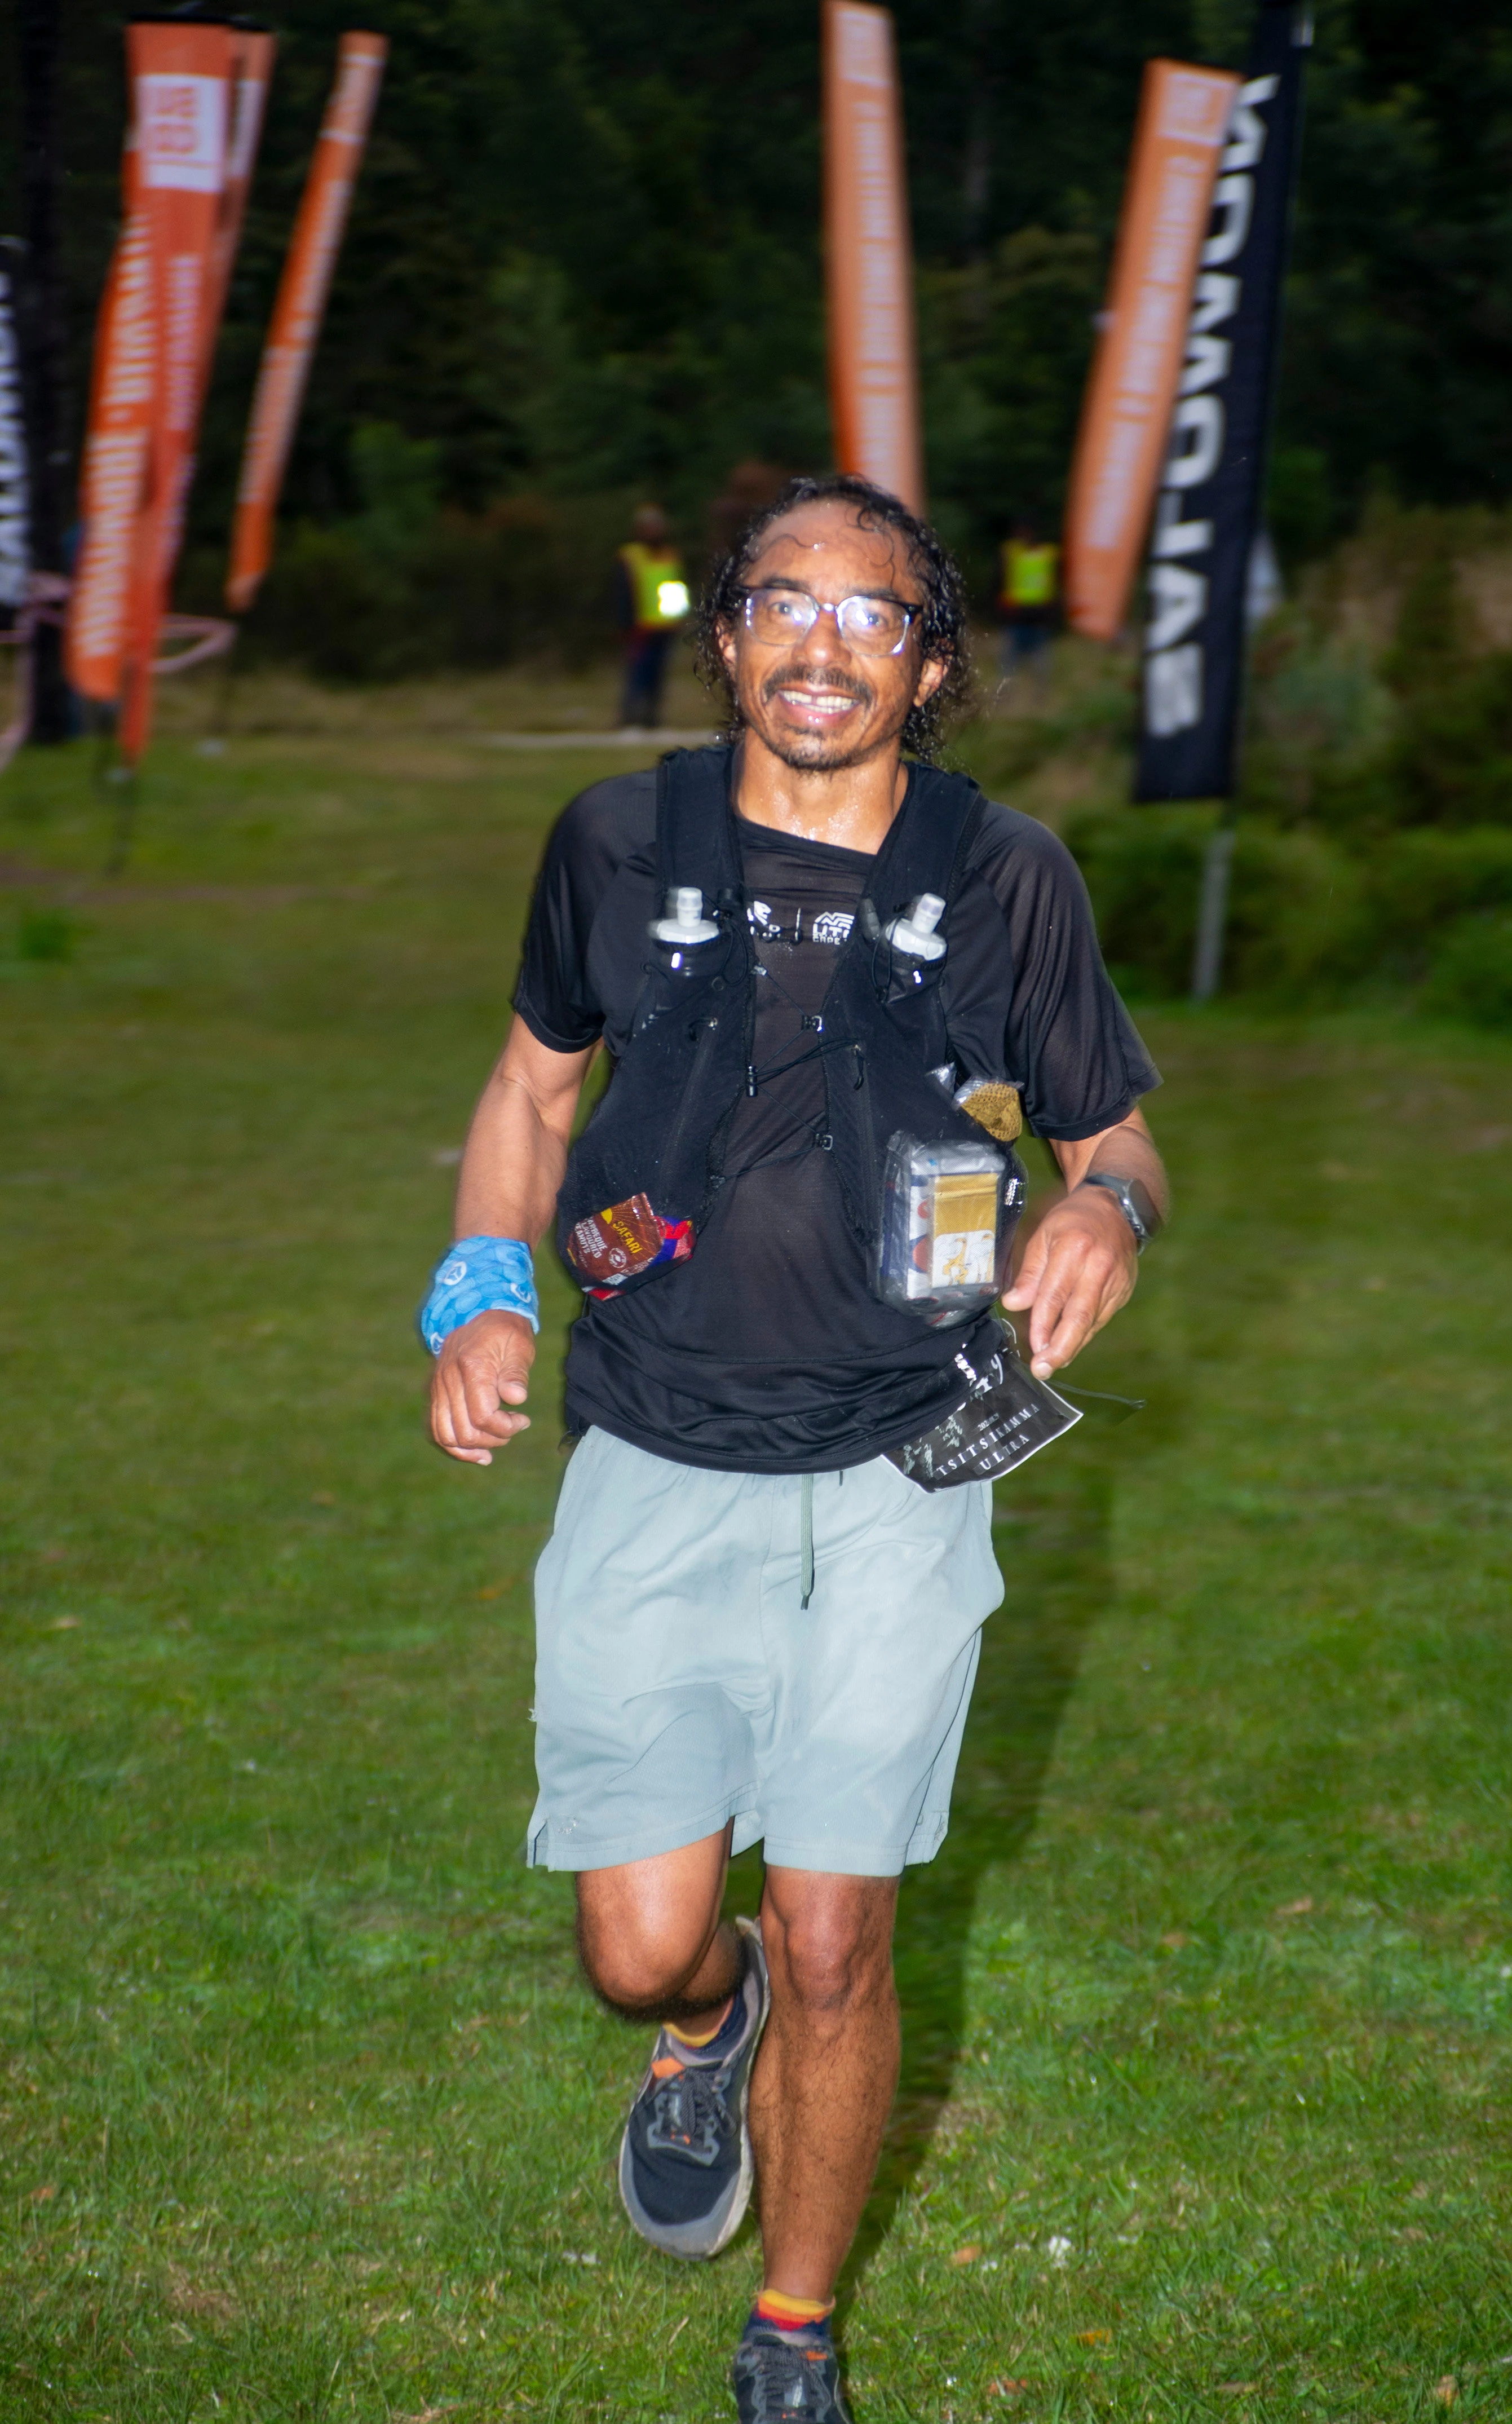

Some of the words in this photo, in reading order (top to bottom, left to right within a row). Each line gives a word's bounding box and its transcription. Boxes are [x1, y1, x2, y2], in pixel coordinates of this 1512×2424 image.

[581, 1221, 602, 1259] LAVOURED
[585, 1217, 607, 1251] ARBEQUE
[613, 1221, 643, 1254] SAFARI
[936, 1403, 1040, 1476] TSITSIKAMMA
[980, 1434, 1030, 1471] ULTRA
